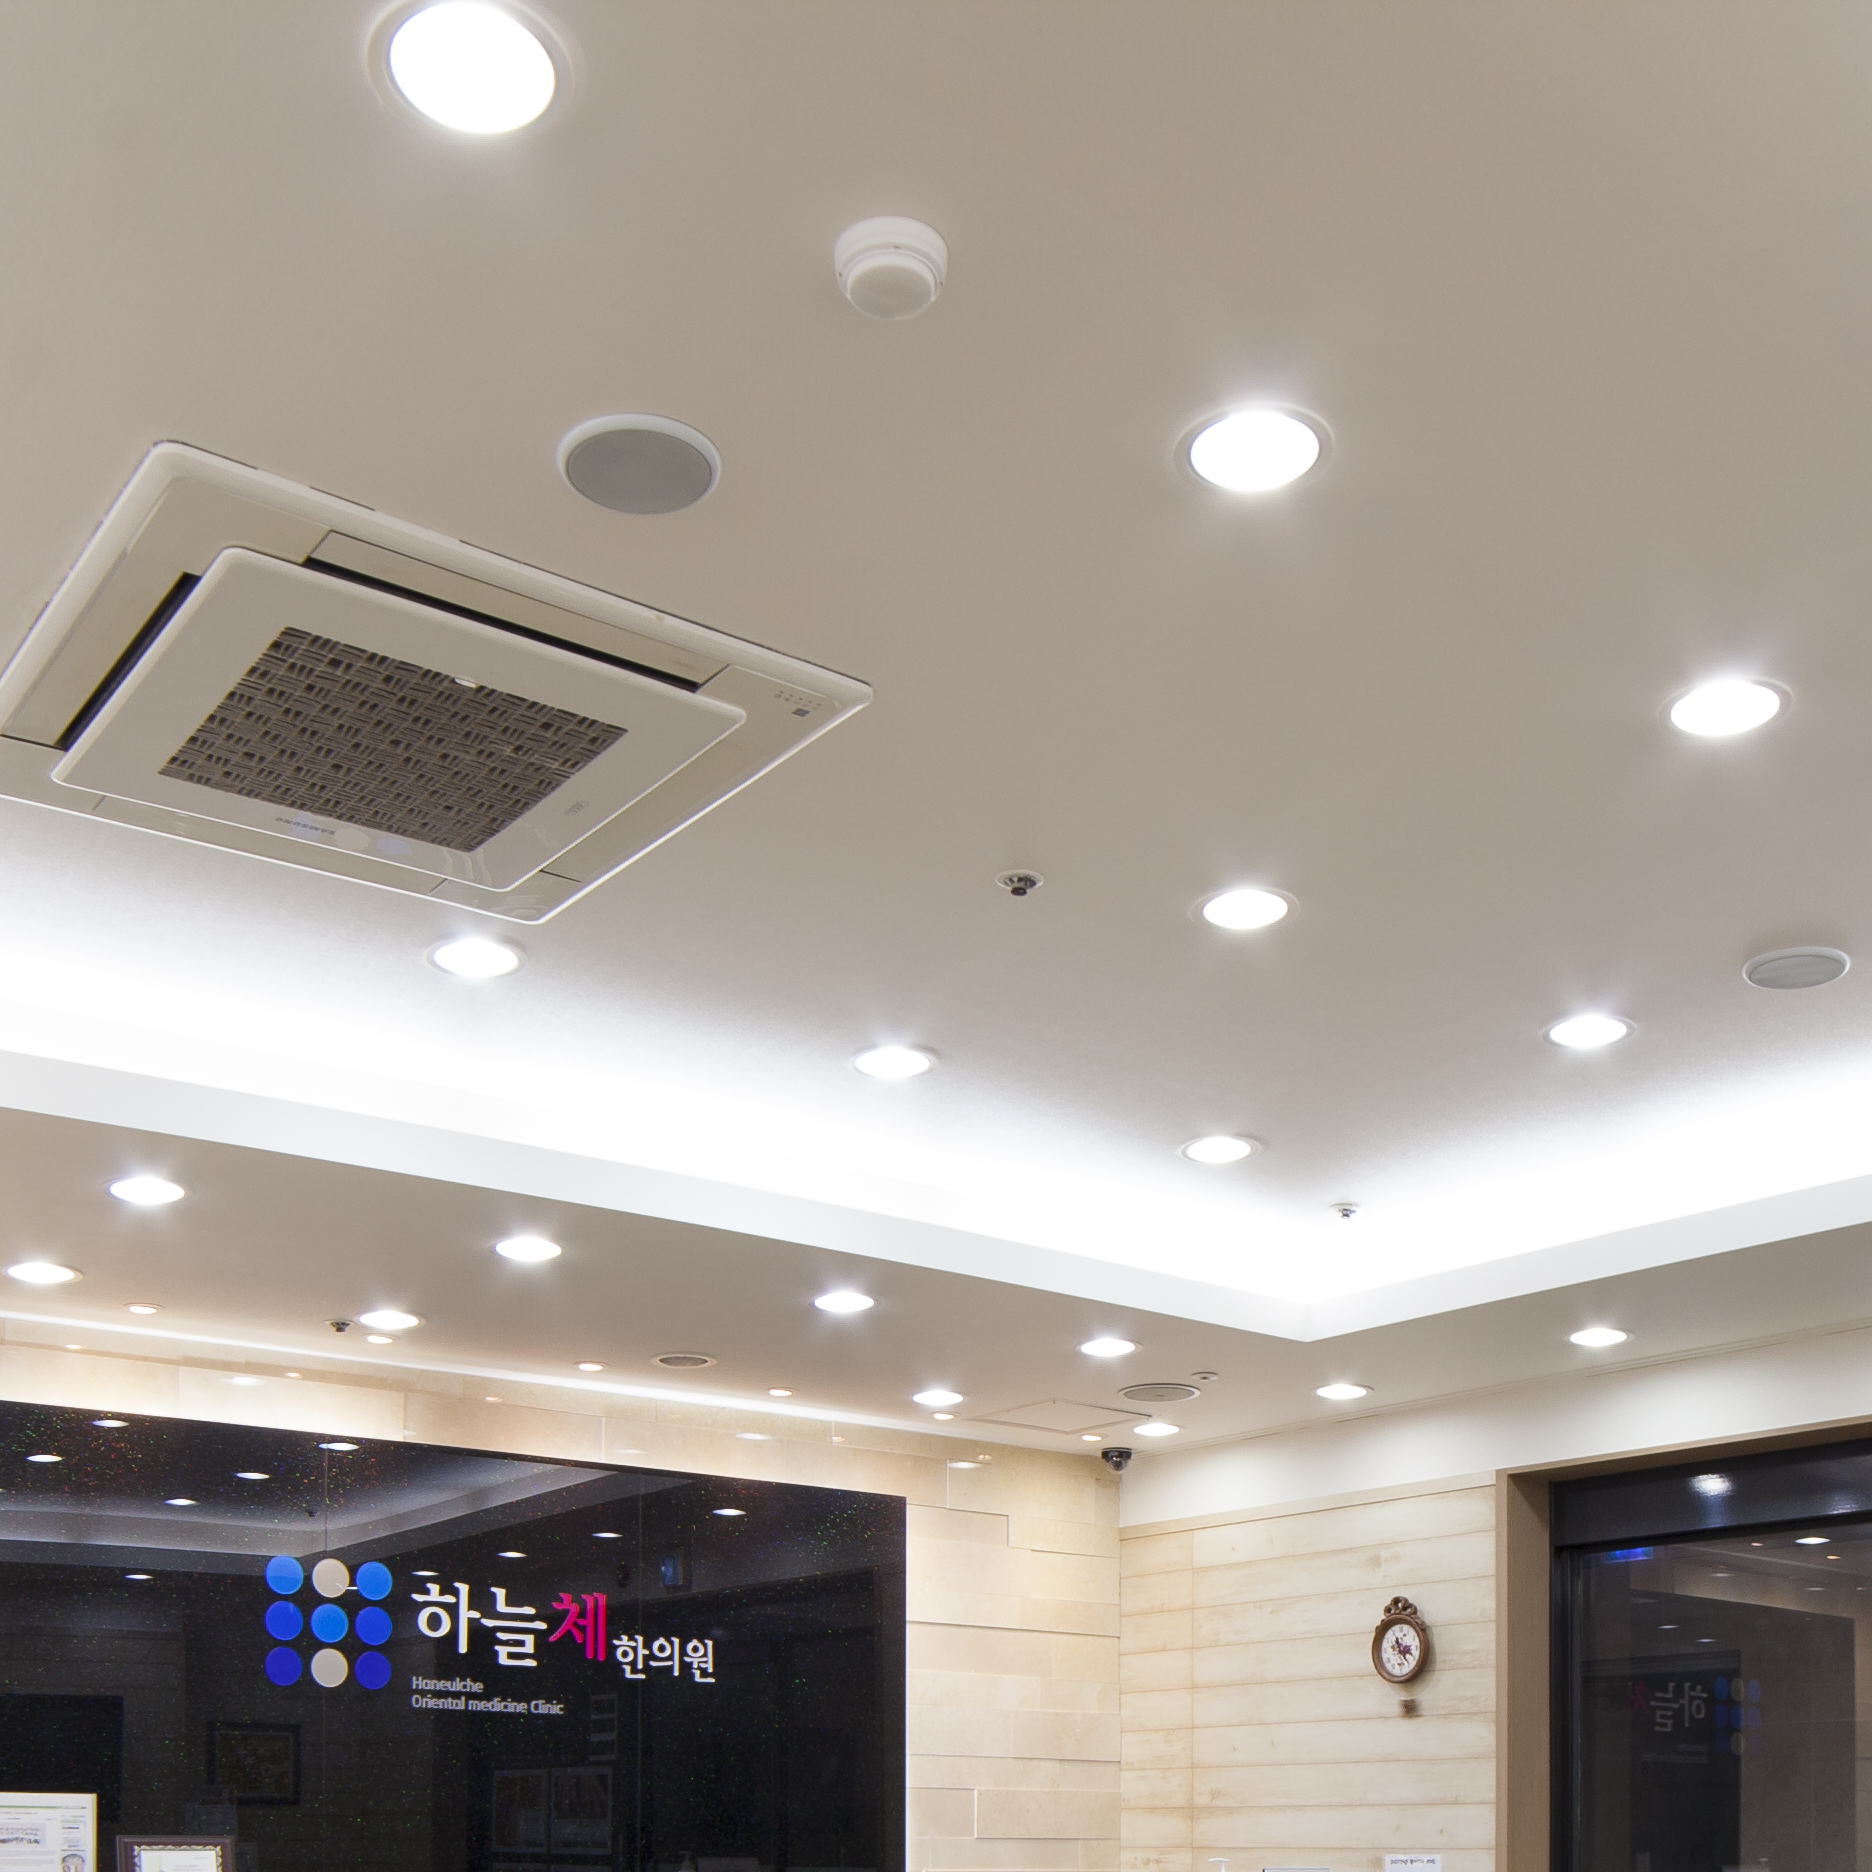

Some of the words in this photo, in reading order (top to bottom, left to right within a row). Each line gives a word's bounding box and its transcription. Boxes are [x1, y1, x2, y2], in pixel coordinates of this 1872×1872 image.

[411, 1676, 485, 1694] Haneulche
[411, 1694, 466, 1712] Oriental
[468, 1697, 528, 1714] medicine
[530, 1699, 565, 1716] Clinic
